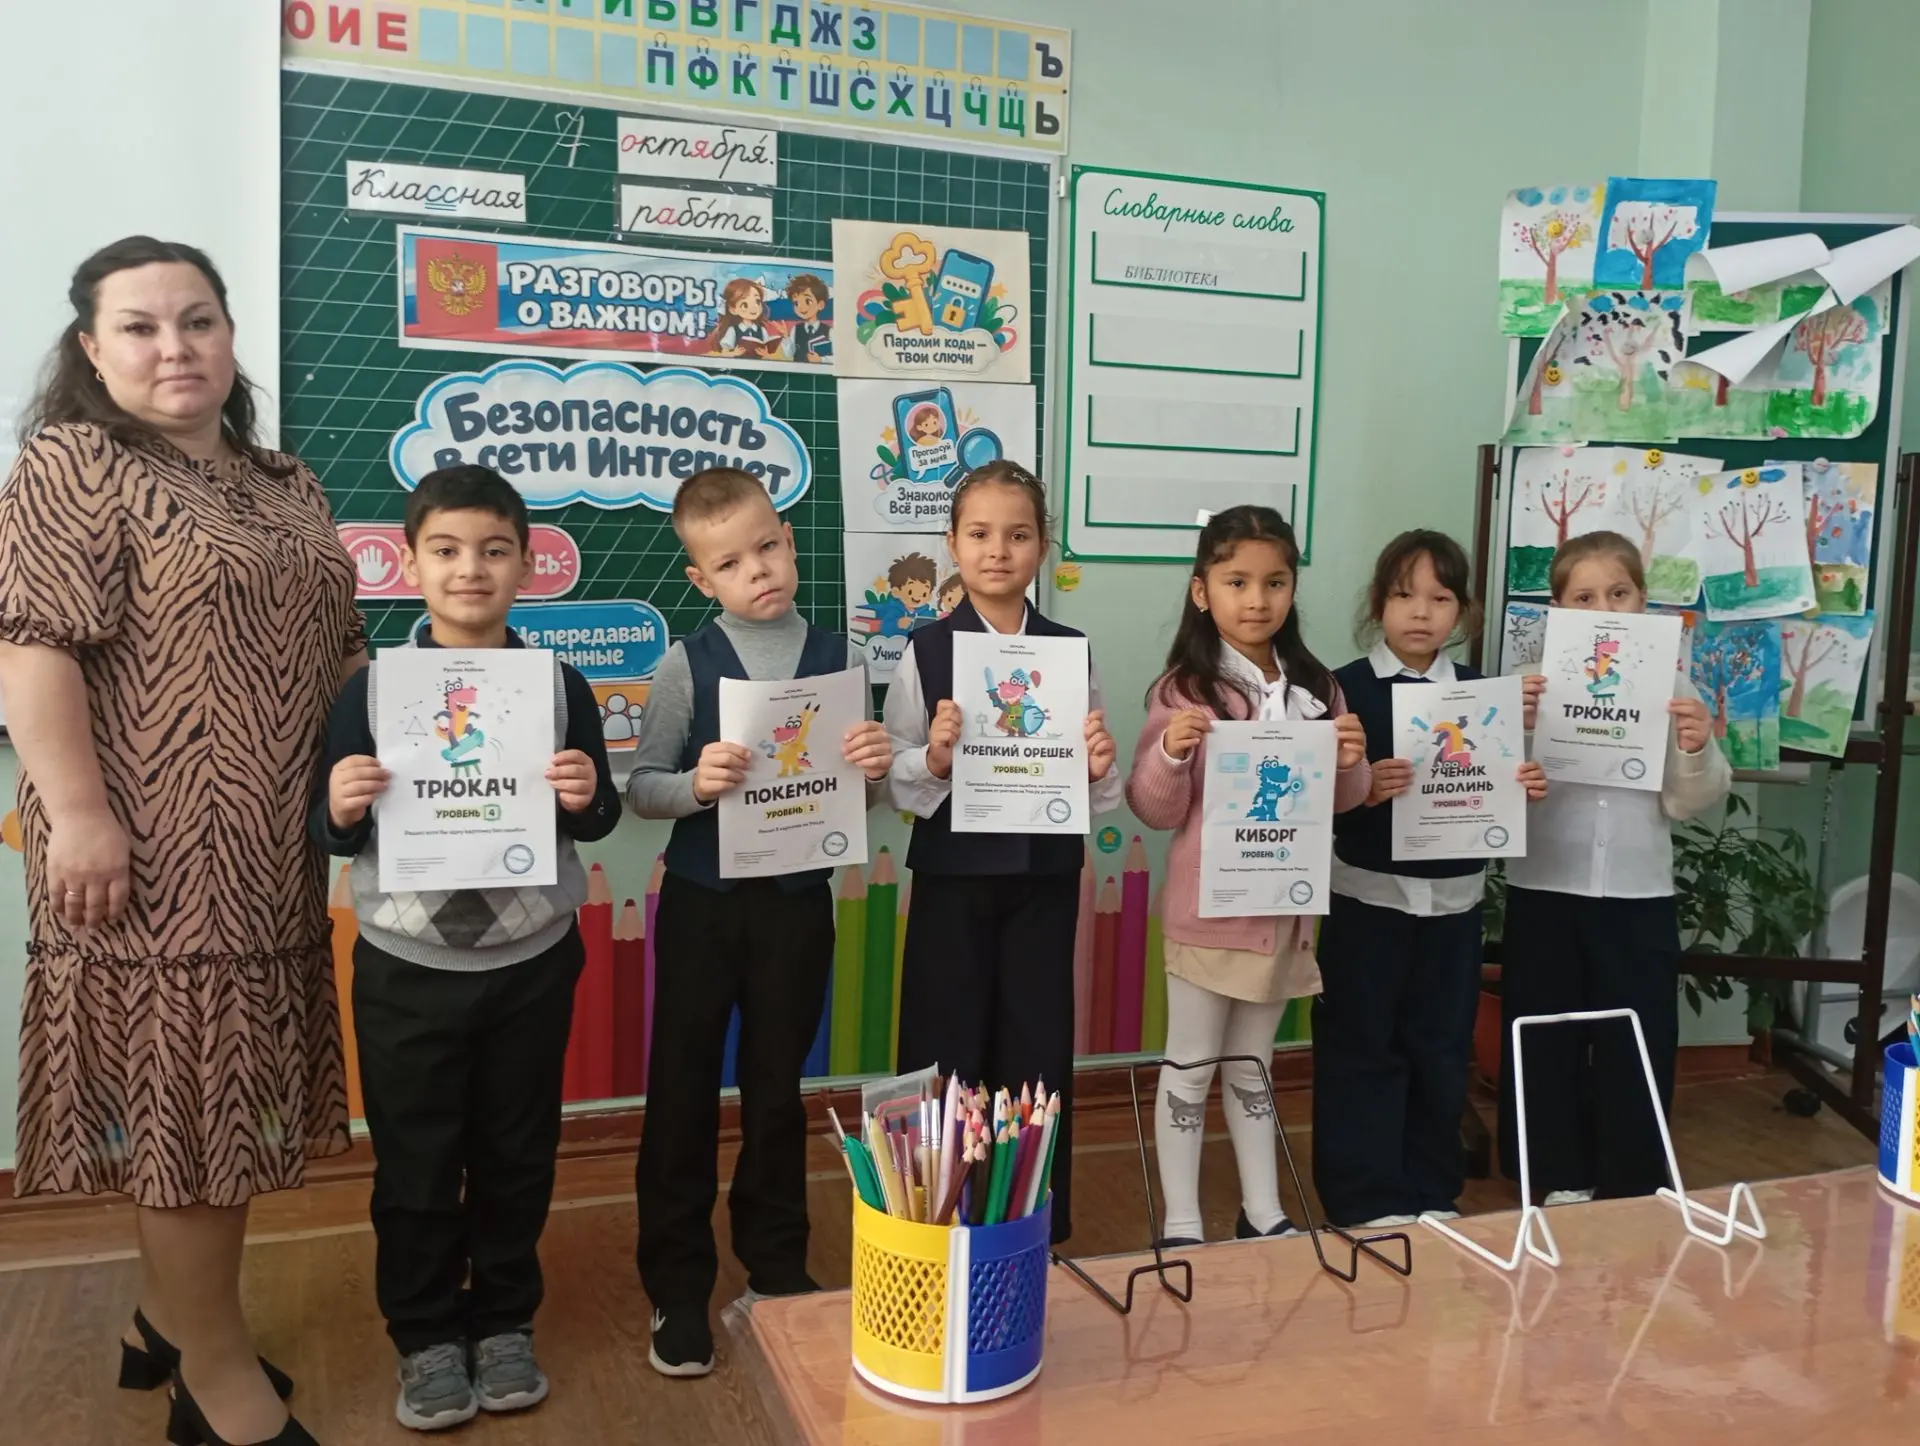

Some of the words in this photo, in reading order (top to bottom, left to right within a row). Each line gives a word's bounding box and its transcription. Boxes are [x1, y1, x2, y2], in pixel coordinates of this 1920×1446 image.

[329, 5, 360, 46] И
[377, 12, 408, 51] Е
[691, 0, 718, 27] В
[735, 0, 757, 32] Г
[770, 4, 800, 47] Д
[810, 9, 842, 46] Ж
[853, 16, 876, 50] З
[1036, 42, 1063, 78] Ъ
[648, 49, 674, 86] П
[688, 56, 718, 90] Ф
[733, 60, 757, 96] К
[772, 65, 797, 100] Т
[810, 70, 839, 107] Ш
[850, 77, 876, 111] С
[888, 81, 914, 117] Х
[926, 87, 951, 128] Ц
[964, 92, 987, 126] Ч
[999, 97, 1025, 137] Щ
[1036, 101, 1060, 135] Ь
[351, 168, 525, 210] Классная
[1103, 187, 1225, 232] Словарные
[1232, 206, 1295, 233] слова
[508, 263, 718, 309] РАЗГОВОРЫ
[1124, 265, 1218, 287] БИБЛИОТЕКА
[518, 300, 543, 327] О
[548, 301, 707, 338] ВАЖНОМ!
[944, 338, 975, 350] коды
[444, 392, 767, 451] Безопасность
[478, 441, 576, 476] сети
[889, 501, 912, 514] Всё
[543, 620, 655, 650] передавай
[555, 648, 625, 667] анные
[1563, 704, 1640, 723] ТРЮКАЧ
[963, 744, 1020, 757] КРЕПКИЙ
[1024, 747, 1074, 758] ОРЕШЕК
[994, 765, 1029, 774] УРОВЕНЬ
[1431, 765, 1486, 779] УЧЕНИК
[413, 778, 517, 798] ТРЮКАЧ
[745, 777, 838, 805] ПОКЕМОН
[1421, 780, 1494, 795] ШАОЛИНЬ
[436, 809, 481, 819] УРОВЕНЬ
[766, 806, 804, 819] УРОВЕНЬ
[1235, 828, 1298, 843] КИБОРГ
[1241, 850, 1275, 858] УРОВЕНЬ
